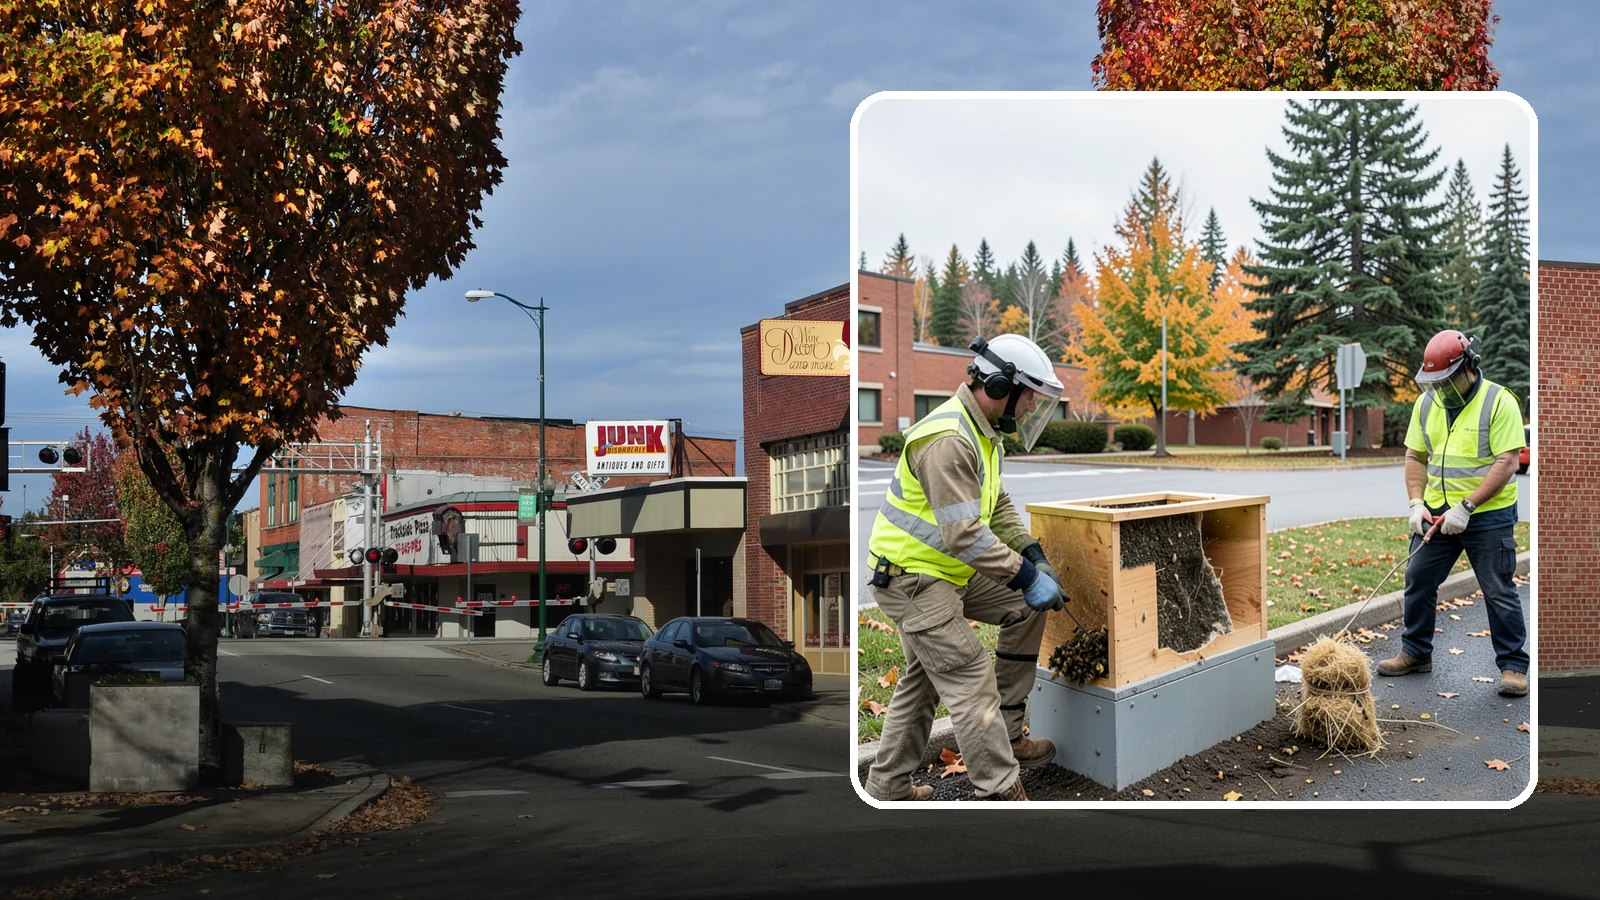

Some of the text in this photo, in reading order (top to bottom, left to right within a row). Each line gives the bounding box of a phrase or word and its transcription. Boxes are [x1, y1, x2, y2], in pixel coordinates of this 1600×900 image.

[595, 425, 665, 457] JUNK
[607, 446, 645, 454] DISORDERLY
[597, 460, 665, 470] ANTIQUES AND GIFTS
[390, 519, 429, 539] Trackside Pizza
